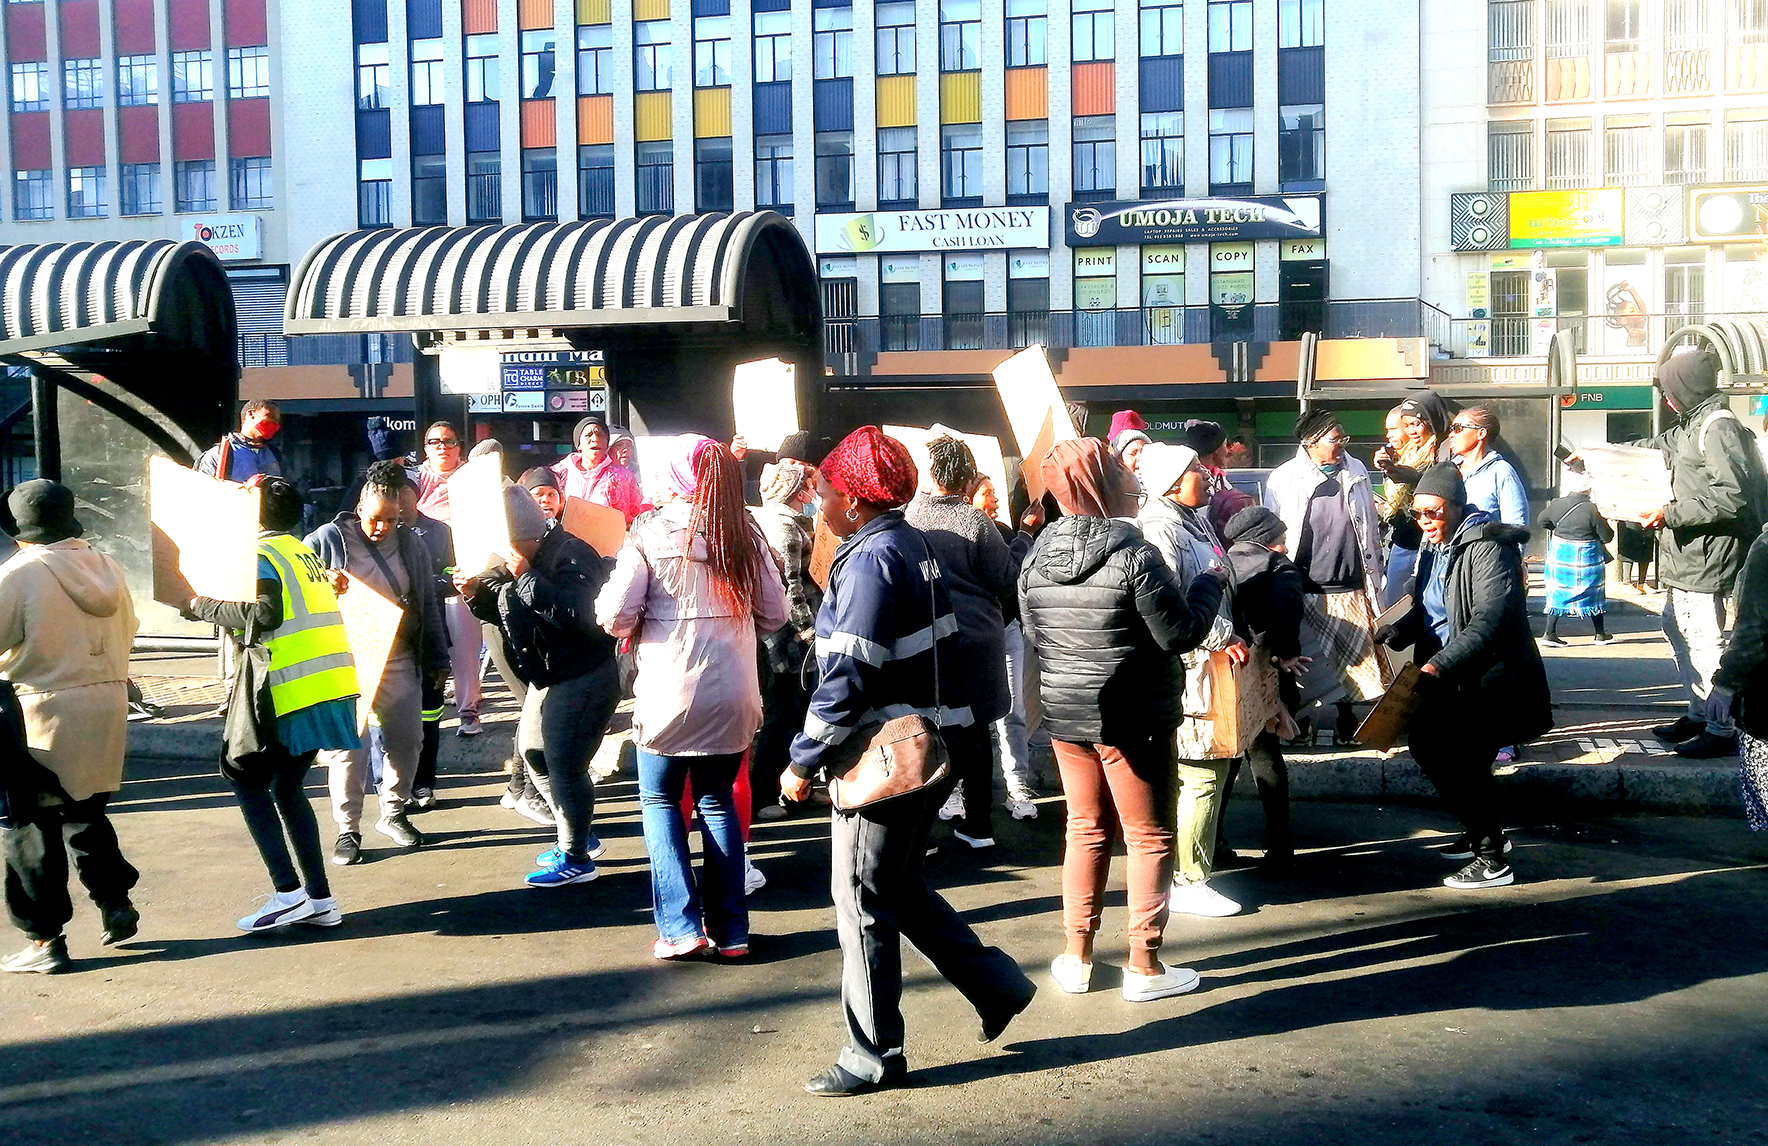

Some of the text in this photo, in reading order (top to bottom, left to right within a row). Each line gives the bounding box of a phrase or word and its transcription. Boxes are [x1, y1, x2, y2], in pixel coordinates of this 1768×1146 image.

[898, 210, 1034, 231] FAST MONEY
[1119, 206, 1266, 228] UMOJA TECH
[193, 223, 244, 241] TOKZEN
[932, 235, 1005, 248] CASH LOAN
[1291, 244, 1314, 254] FAX
[1078, 256, 1112, 266] PRINT
[1147, 254, 1180, 264] SCAN
[1215, 251, 1248, 262] COPY
[1581, 393, 1603, 402] FNB
